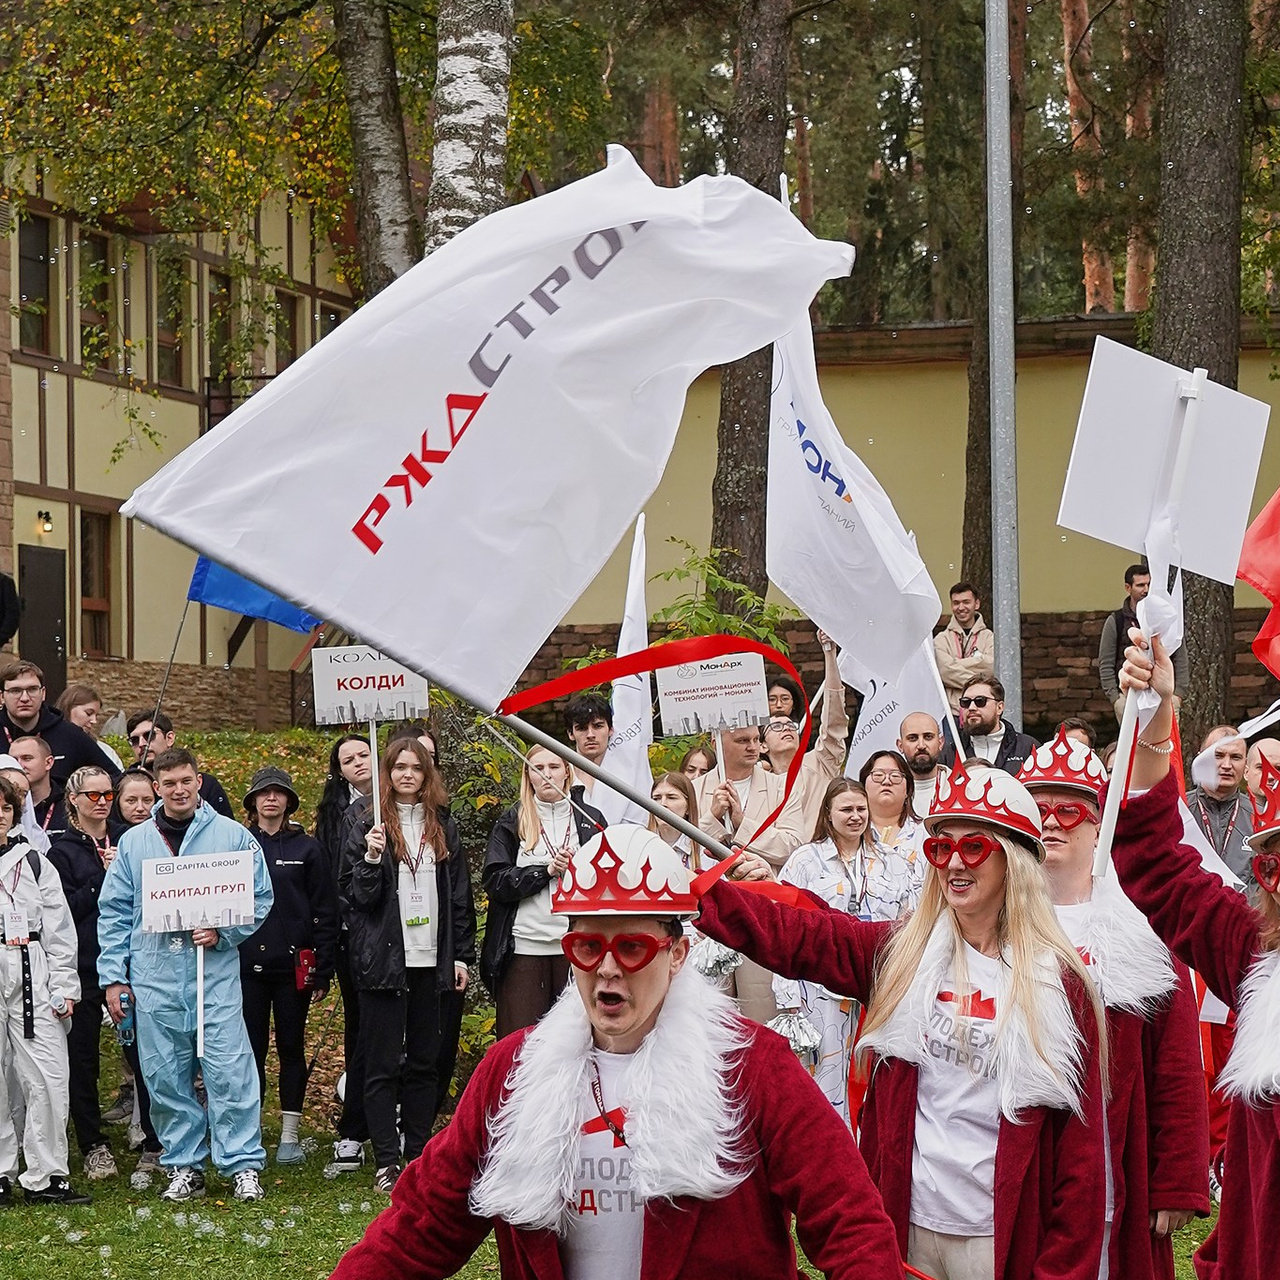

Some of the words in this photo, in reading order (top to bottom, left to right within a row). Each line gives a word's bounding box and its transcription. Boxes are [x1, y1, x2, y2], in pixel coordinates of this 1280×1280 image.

[351, 220, 648, 555] РЖДСТРО
[336, 674, 405, 691] КОЛДИ
[663, 687, 700, 697] КОМБИНАТ
[700, 680, 762, 692] ИННОВАЦИОННЫХ
[673, 691, 719, 703] ТЕХНОЛОГИЙ
[724, 688, 753, 697] МОНАРХ
[158, 865, 172, 873] CG
[176, 861, 210, 871] CAPITAL
[211, 859, 240, 868] GROUP
[150, 885, 211, 900] КАПИТАЛ
[214, 883, 246, 895] ГРУП
